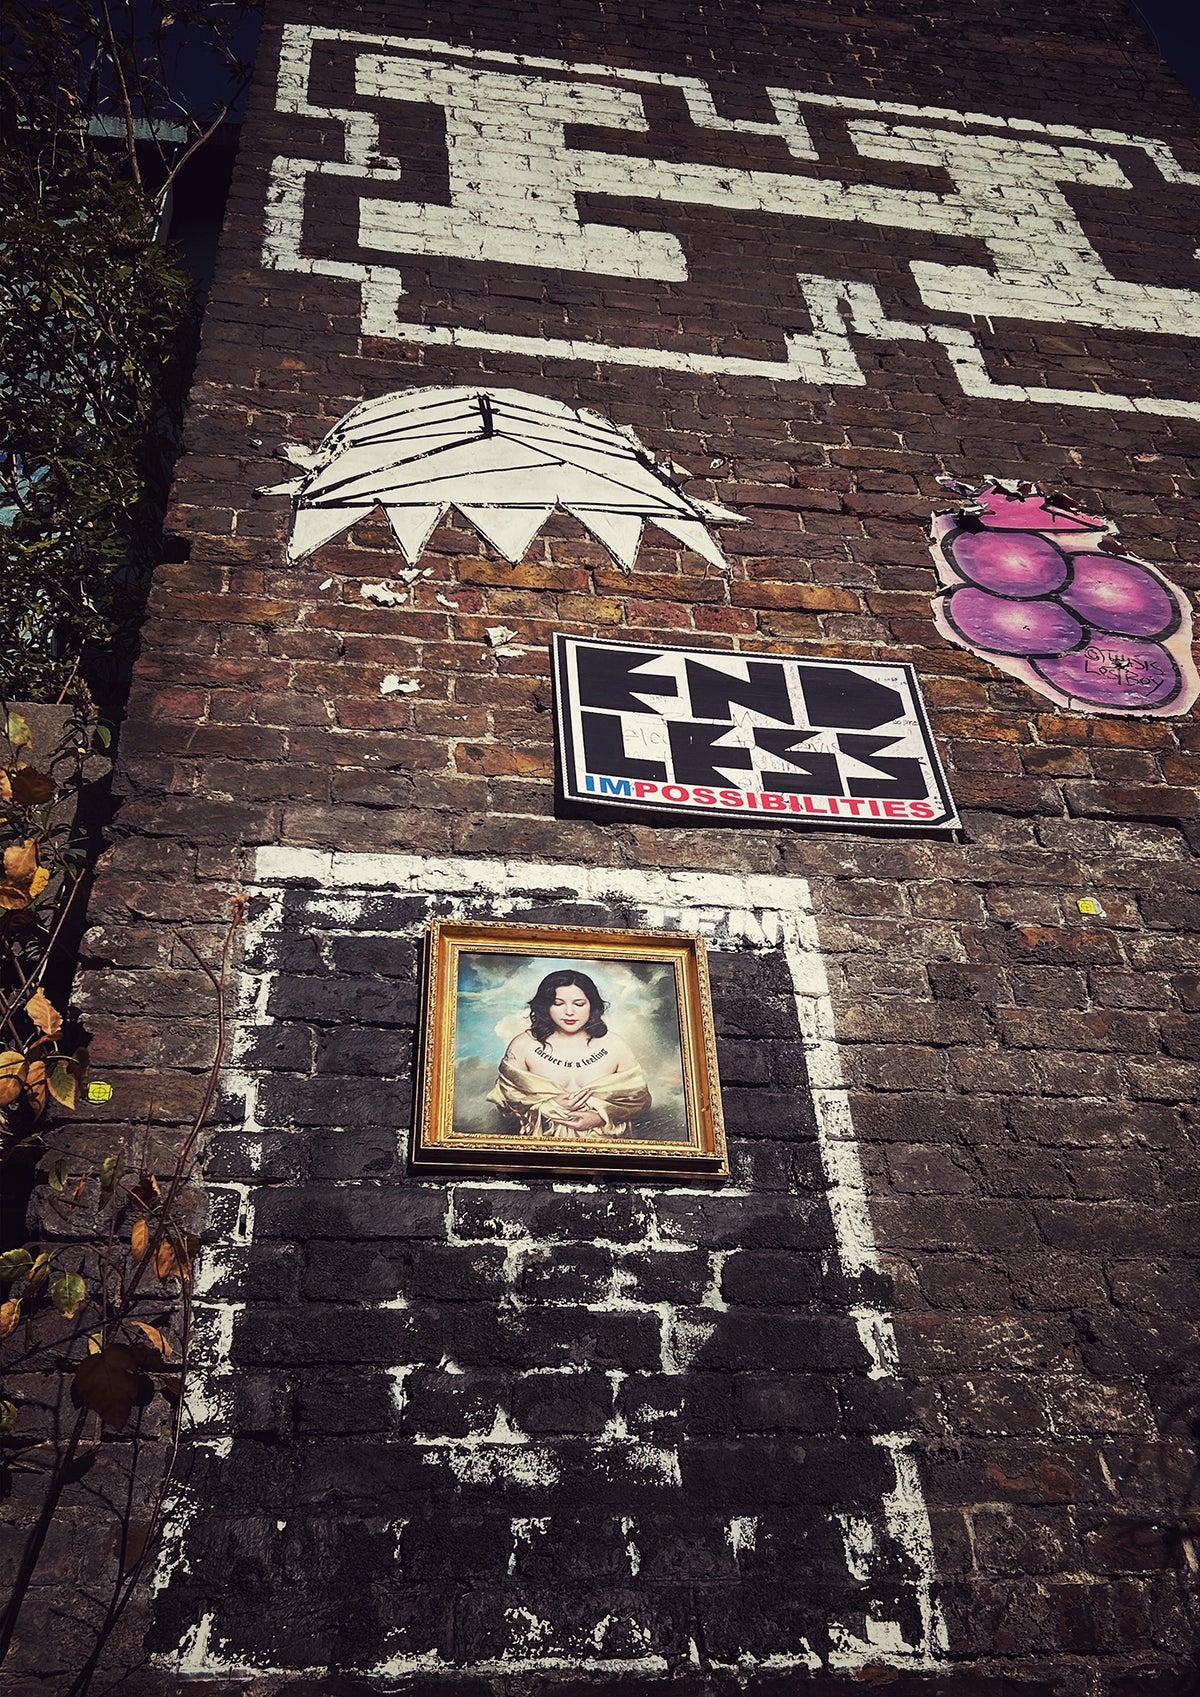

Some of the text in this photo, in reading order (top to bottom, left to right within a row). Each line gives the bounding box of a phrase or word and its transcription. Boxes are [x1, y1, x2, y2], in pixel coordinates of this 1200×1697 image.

[575, 645, 906, 730] END
[580, 710, 929, 800] LESS
[585, 774, 935, 819] IMPOSSIBILITIES
[564, 1060, 573, 1068] is
